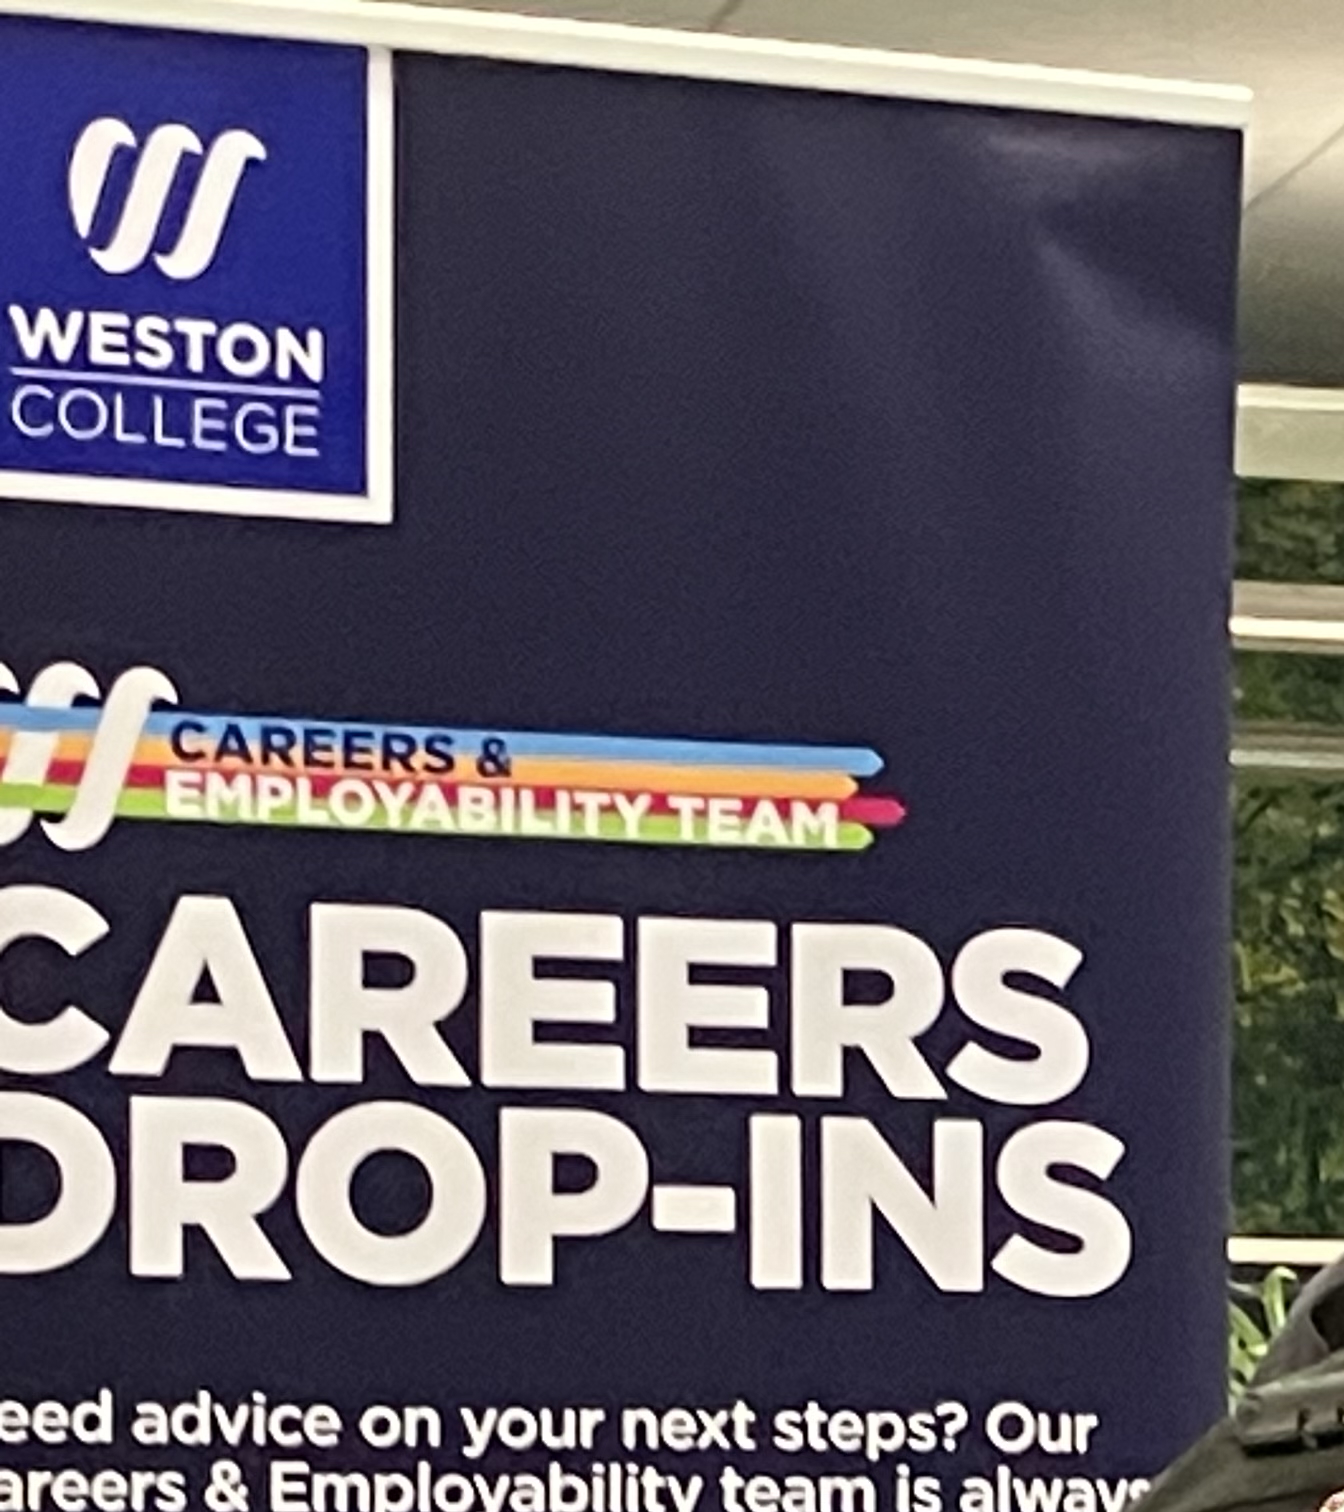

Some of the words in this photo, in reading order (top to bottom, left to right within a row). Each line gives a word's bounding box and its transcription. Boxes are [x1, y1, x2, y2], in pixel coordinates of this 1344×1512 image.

[9, 305, 323, 382] WESTON
[12, 385, 319, 456] COLLEGE
[170, 720, 455, 773] CAREERS
[476, 737, 511, 777] &
[165, 769, 651, 838] EMPLOYABILITY
[667, 796, 840, 847] TEAM
[0, 886, 1089, 1104] CAREERS
[0, 1091, 1130, 1297] DROP-INS
[0, 1388, 112, 1443] eed
[132, 1390, 342, 1446] advice
[359, 1406, 440, 1447] on
[461, 1408, 605, 1458] your
[623, 1400, 755, 1450] next
[774, 1401, 968, 1460] steps?
[986, 1402, 1098, 1454] Our
[0, 1469, 186, 1512] areers
[205, 1460, 248, 1512] &
